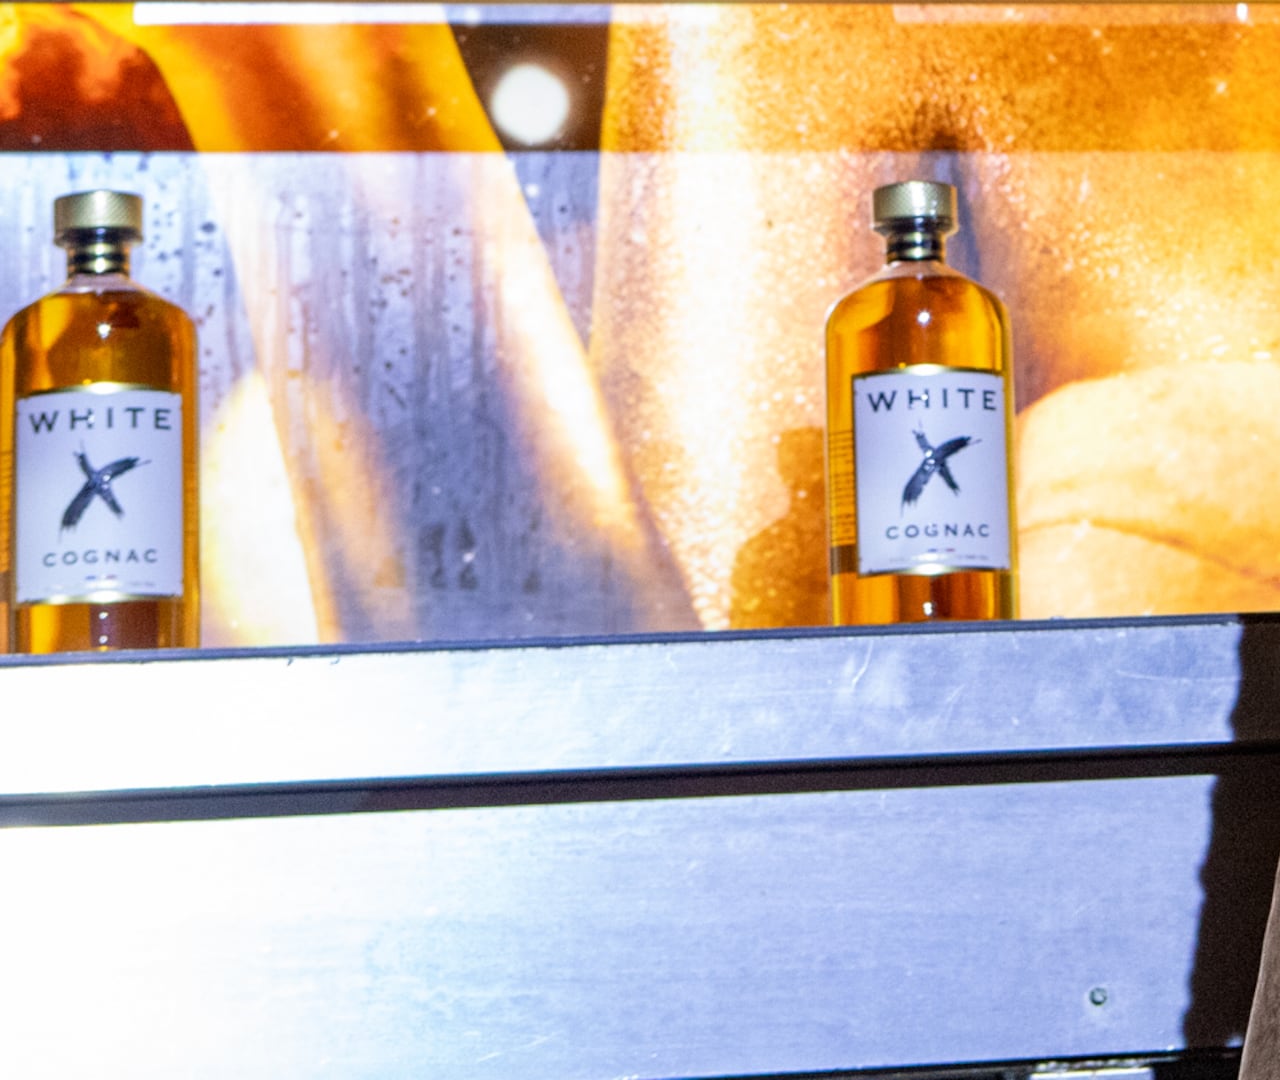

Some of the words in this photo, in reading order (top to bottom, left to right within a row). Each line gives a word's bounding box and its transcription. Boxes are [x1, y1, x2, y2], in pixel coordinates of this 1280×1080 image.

[868, 388, 997, 414] WHITE
[29, 407, 172, 435] WHITE
[901, 423, 981, 513] X
[60, 444, 152, 539] X
[885, 524, 990, 540] COGNAC
[42, 549, 158, 567] COGNAC
